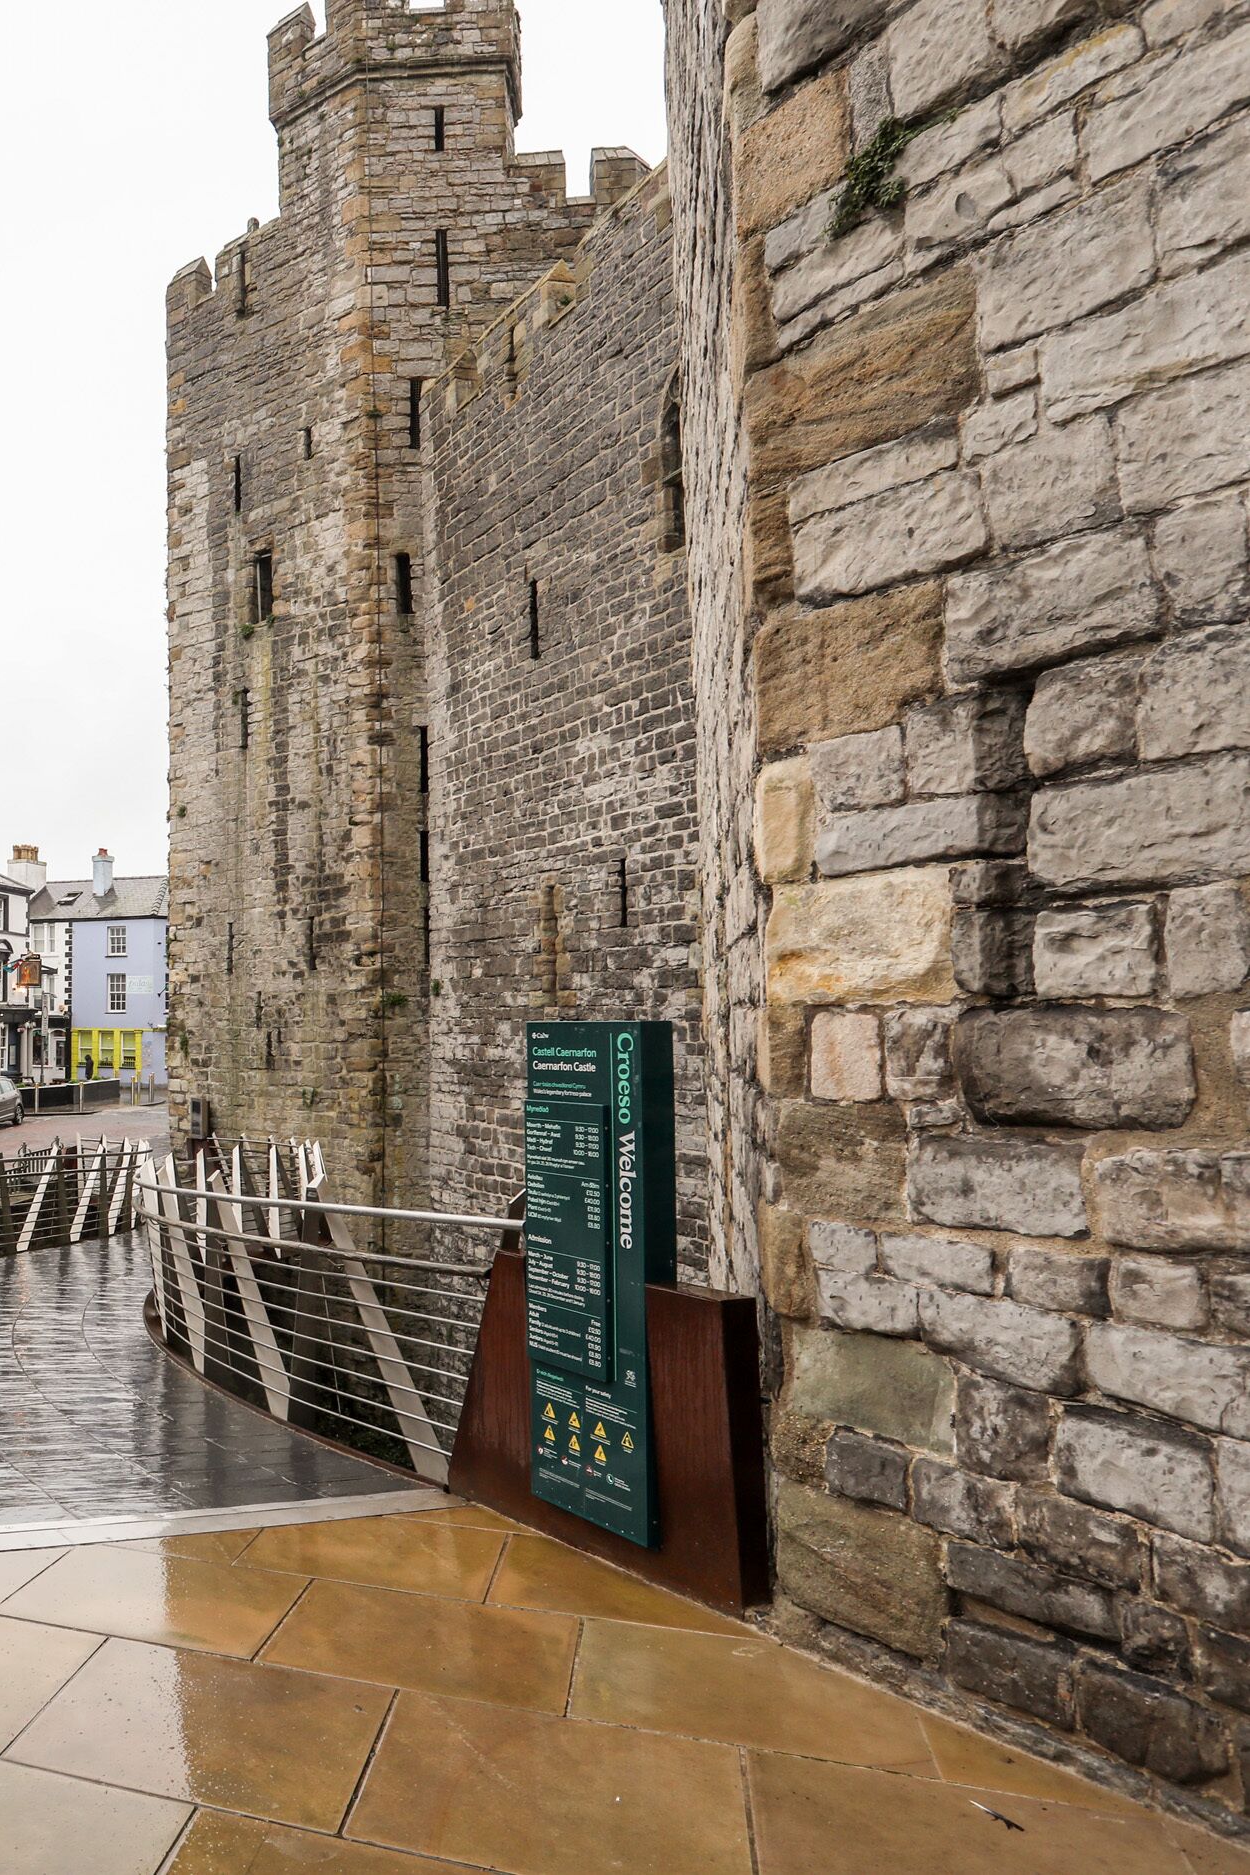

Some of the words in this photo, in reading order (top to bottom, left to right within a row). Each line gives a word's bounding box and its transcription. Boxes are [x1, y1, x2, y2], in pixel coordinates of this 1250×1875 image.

[532, 1047, 555, 1057] Castell
[555, 1047, 597, 1058] Caernarfon
[532, 1061, 573, 1071] Caernarfon
[573, 1062, 597, 1073] Castle
[617, 1032, 634, 1124] Croeso
[618, 1130, 637, 1249] Welcome
[527, 1234, 552, 1245] Admission
[543, 1253, 553, 1261] June
[539, 1260, 553, 1269] August
[552, 1271, 569, 1280] October
[551, 1279, 570, 1289] February
[528, 1302, 547, 1312] Members
[529, 1310, 539, 1319] Adult
[529, 1318, 541, 1327] Family
[591, 1319, 601, 1328] Free
[529, 1325, 544, 1334] Seniors
[529, 1333, 543, 1342] Juniors
